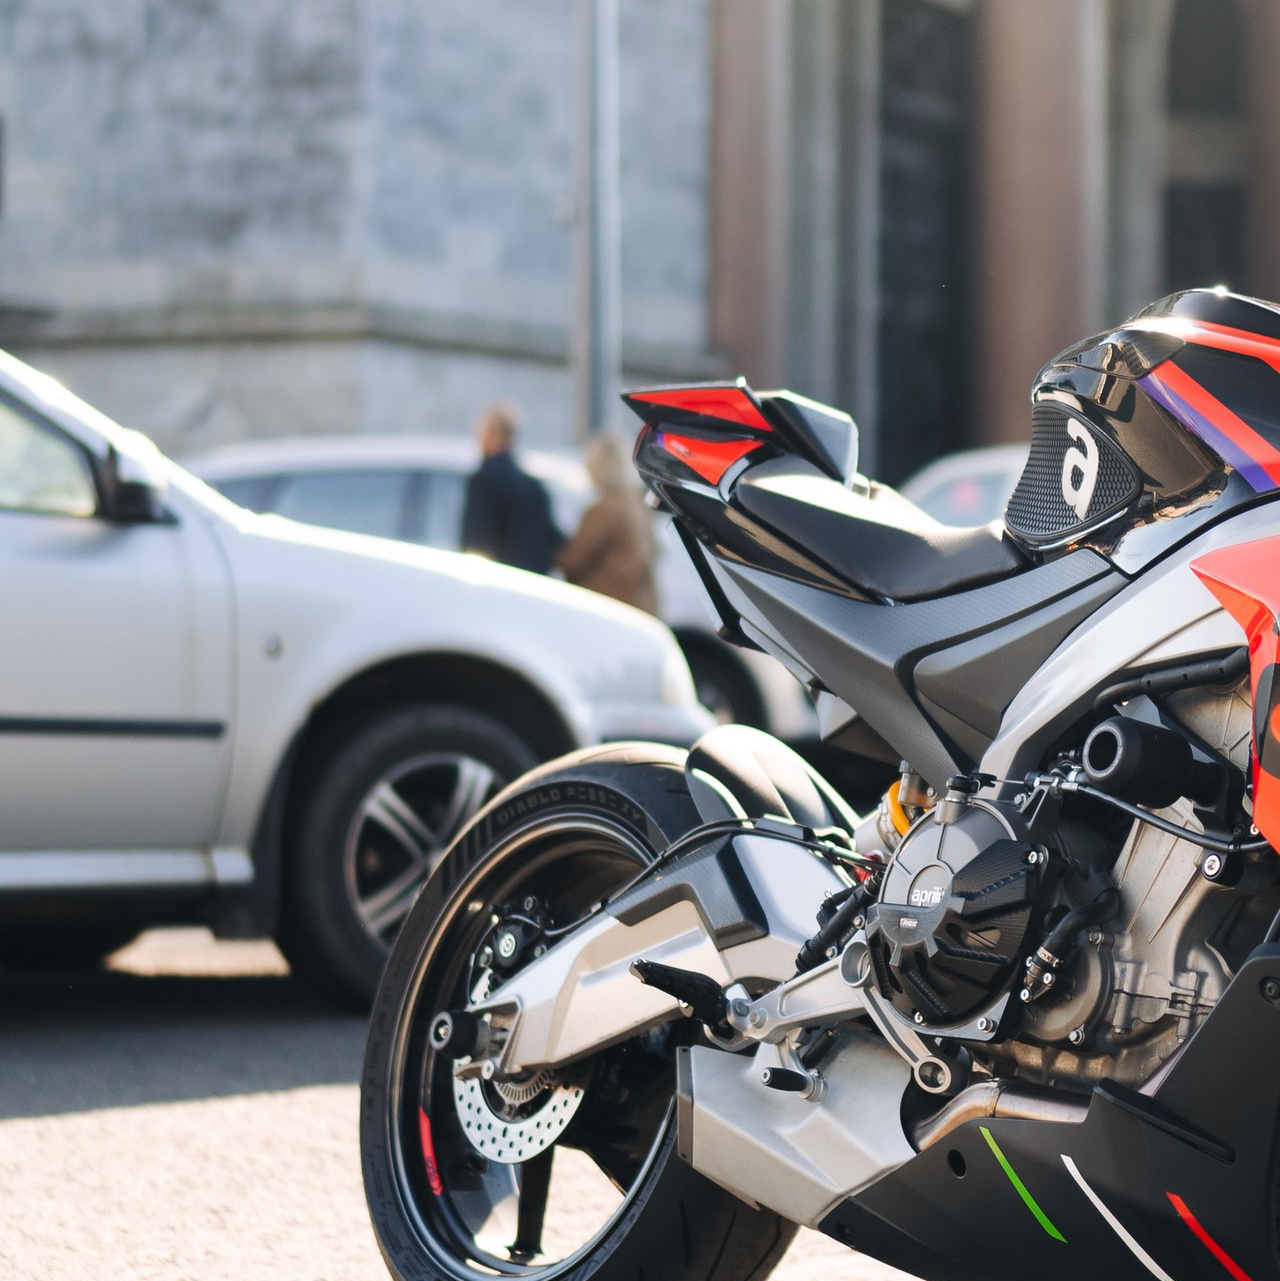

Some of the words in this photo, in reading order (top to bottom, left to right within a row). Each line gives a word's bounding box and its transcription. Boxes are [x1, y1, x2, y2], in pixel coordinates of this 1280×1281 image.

[1062, 418, 1099, 521] a
[496, 788, 562, 825] DIABLO
[911, 886, 945, 907] aprili
